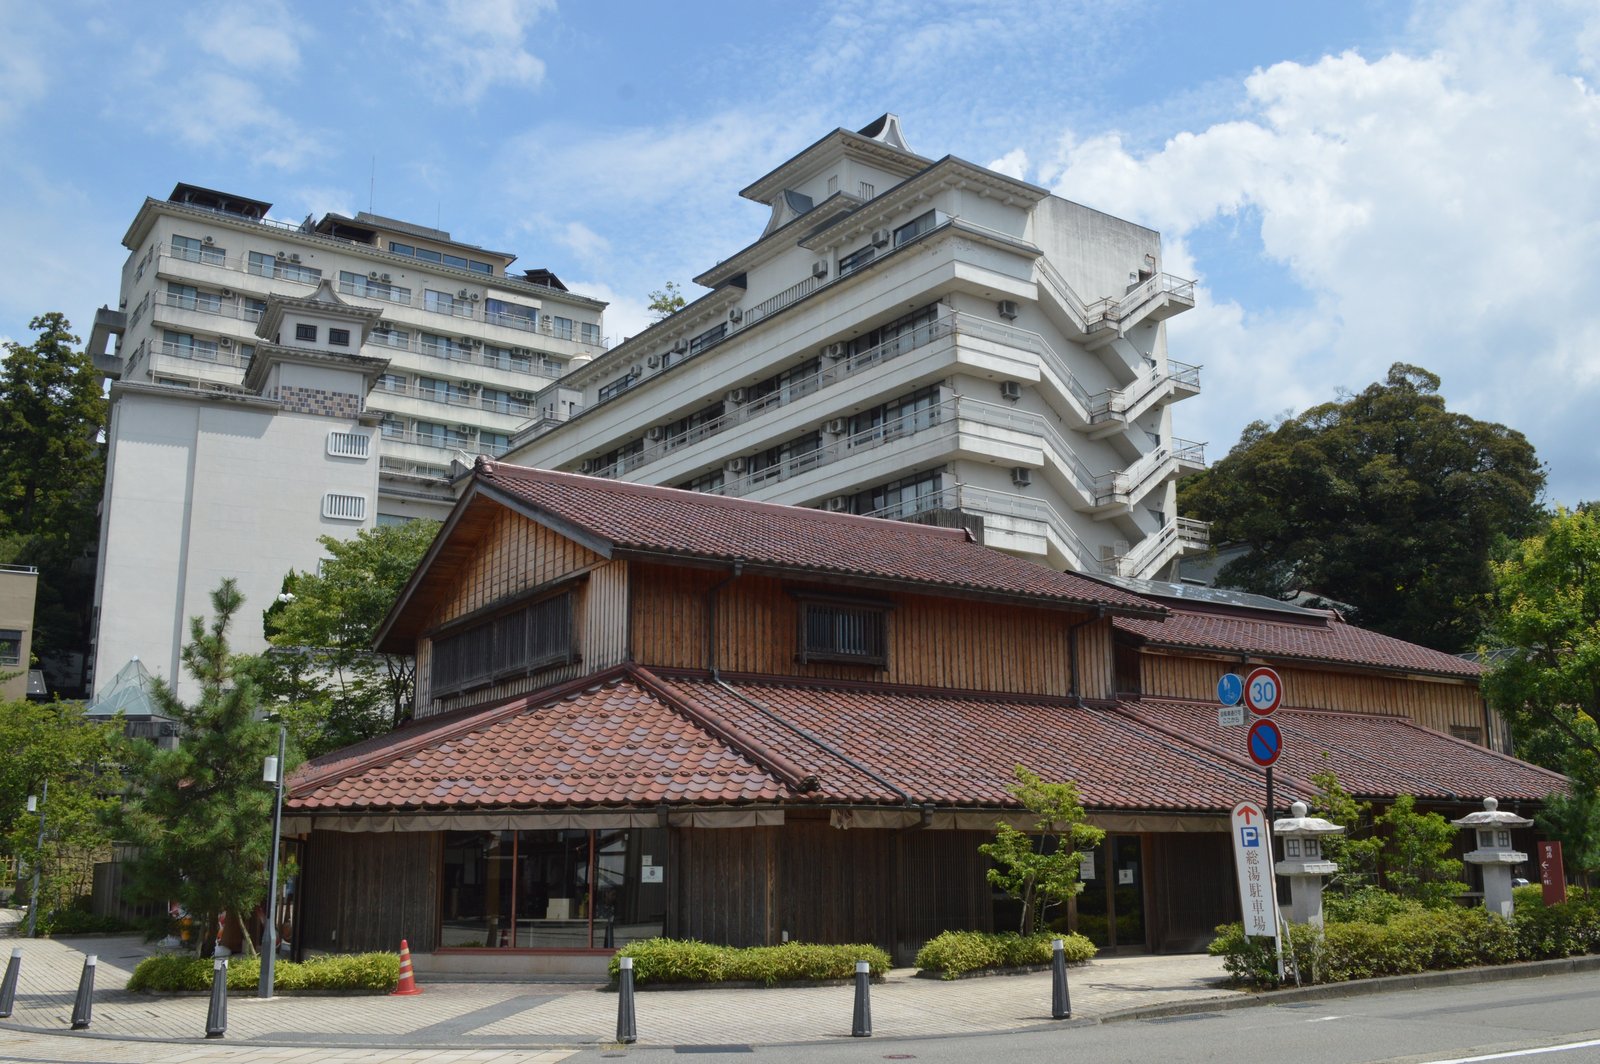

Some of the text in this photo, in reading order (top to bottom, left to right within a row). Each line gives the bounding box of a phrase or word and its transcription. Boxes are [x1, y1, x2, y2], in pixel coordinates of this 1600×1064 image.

[1253, 682, 1274, 703] 30
[1242, 828, 1257, 846] P
[1246, 850, 1266, 932] 総湯駐車場
